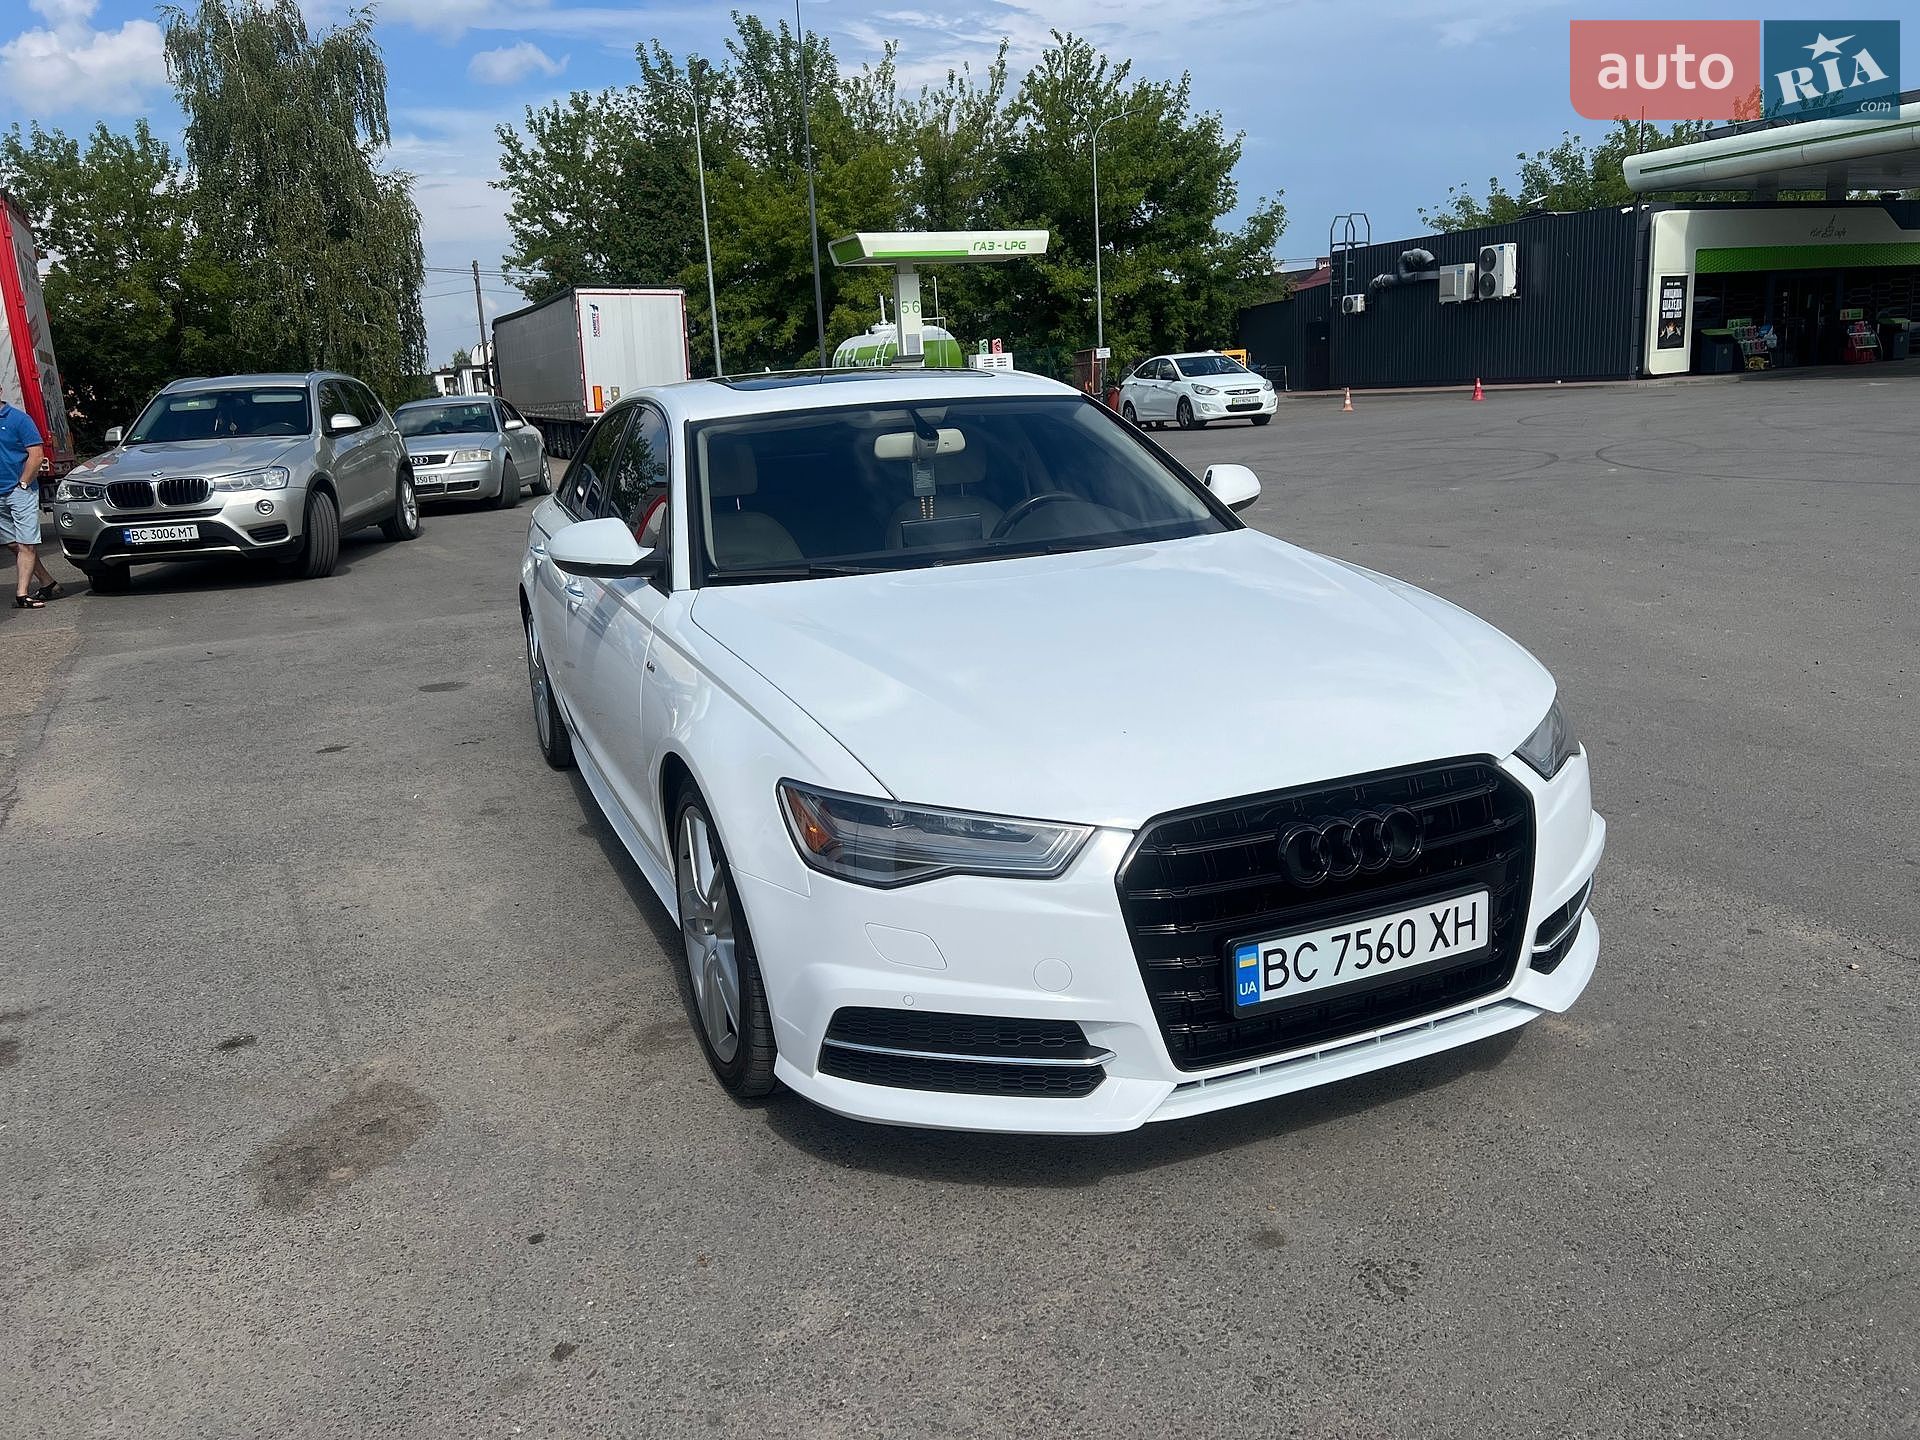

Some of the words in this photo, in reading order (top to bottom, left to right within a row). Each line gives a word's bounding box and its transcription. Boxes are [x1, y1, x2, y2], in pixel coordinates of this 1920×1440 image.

[1004, 241, 1027, 250] LPG
[131, 530, 148, 541] BC
[151, 528, 176, 540] 3006
[178, 526, 194, 538] MT
[1263, 941, 1319, 992] BC
[1331, 918, 1416, 977] 7560
[1428, 901, 1477, 953] XH
[1239, 982, 1258, 996] UA
